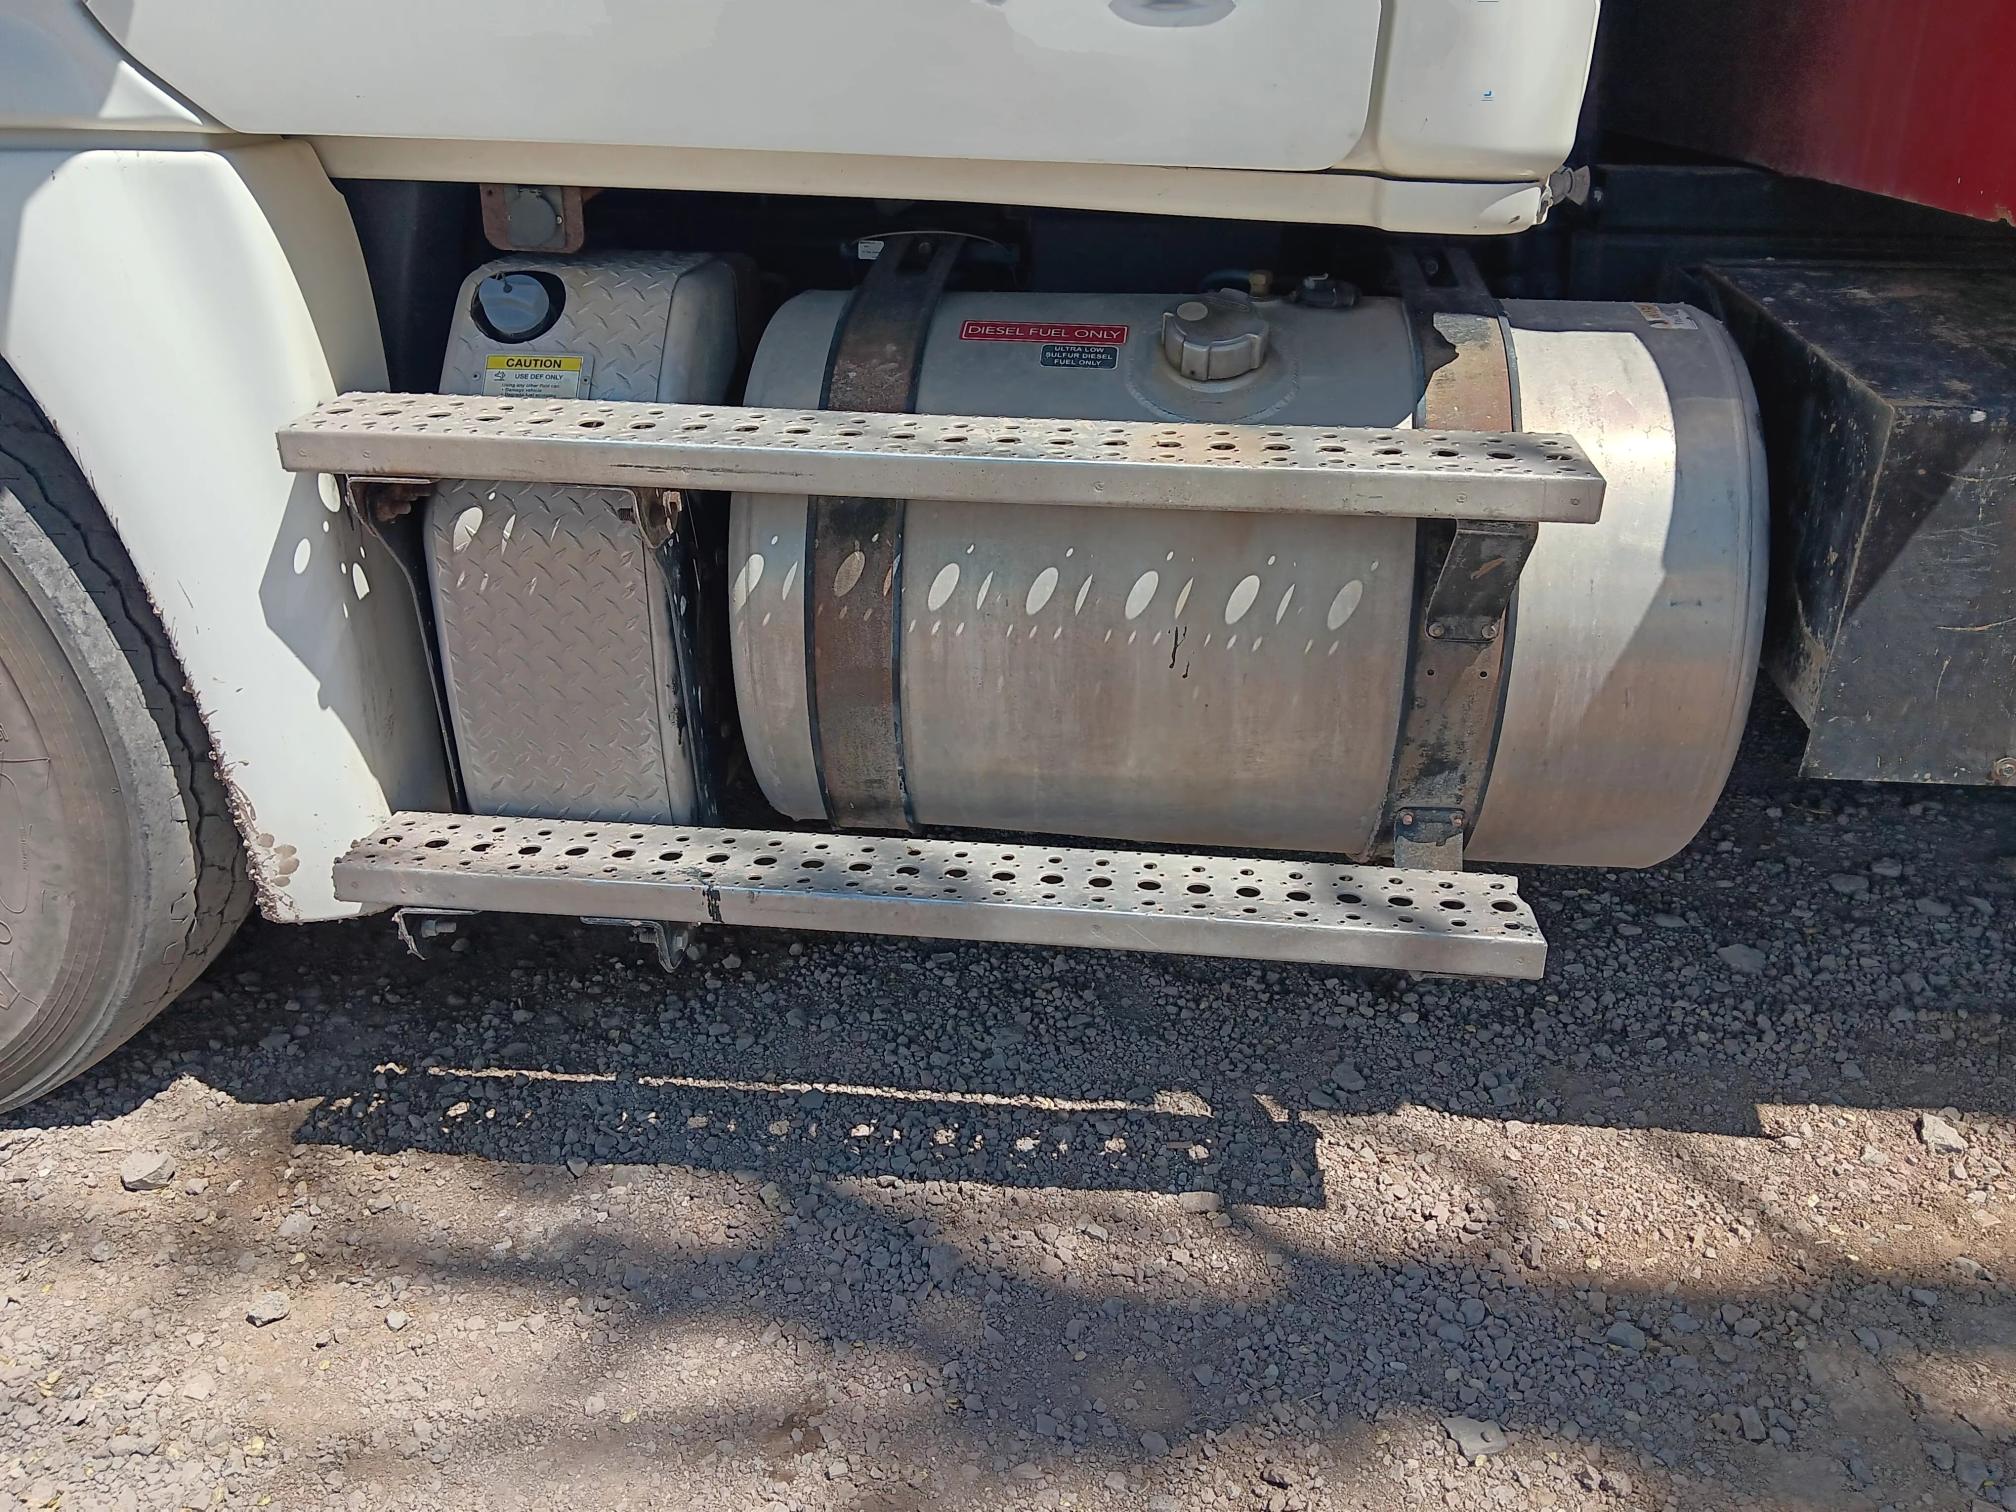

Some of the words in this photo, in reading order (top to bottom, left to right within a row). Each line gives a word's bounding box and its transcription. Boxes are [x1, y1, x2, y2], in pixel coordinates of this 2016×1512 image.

[968, 325, 1025, 336] DIESEL
[1029, 327, 1070, 338] FUEL
[1074, 329, 1121, 339] ONLY
[506, 358, 562, 369] CAUTION
